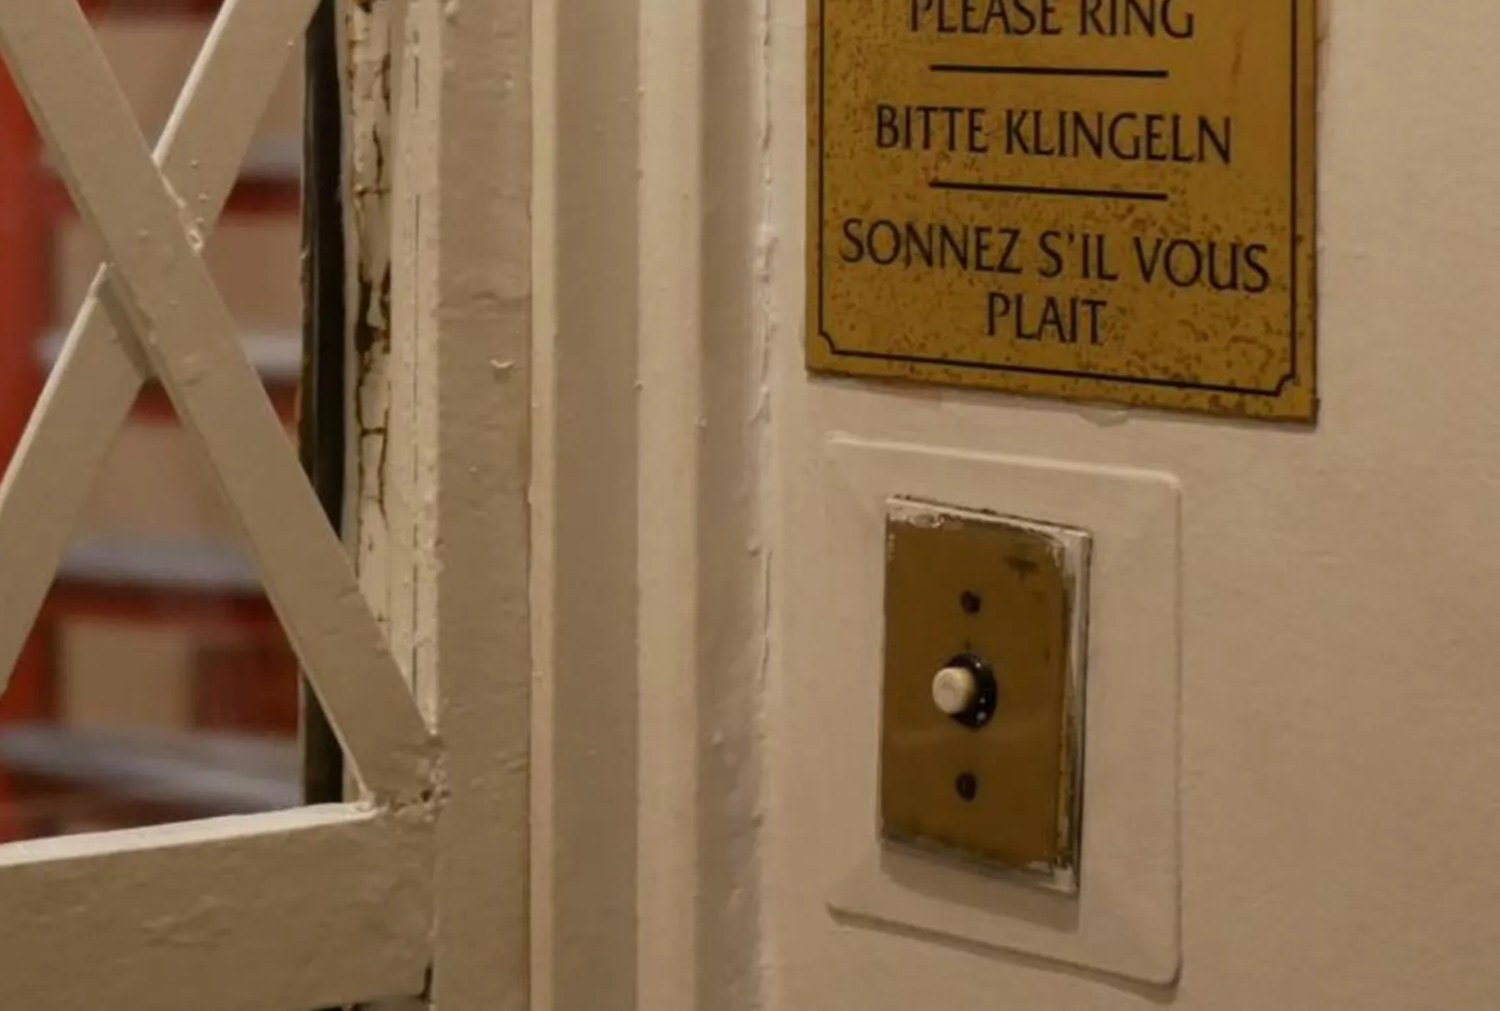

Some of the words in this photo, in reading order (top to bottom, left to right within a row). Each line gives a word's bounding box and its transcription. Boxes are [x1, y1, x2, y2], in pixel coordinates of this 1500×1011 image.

[875, 104, 989, 154] BITTE
[1004, 108, 1233, 165] KLINGELN
[839, 218, 1024, 275] SONNEZ
[1038, 229, 1119, 283] S'IL
[1133, 235, 1271, 293] VOUS
[985, 291, 1108, 345] PLAIT
